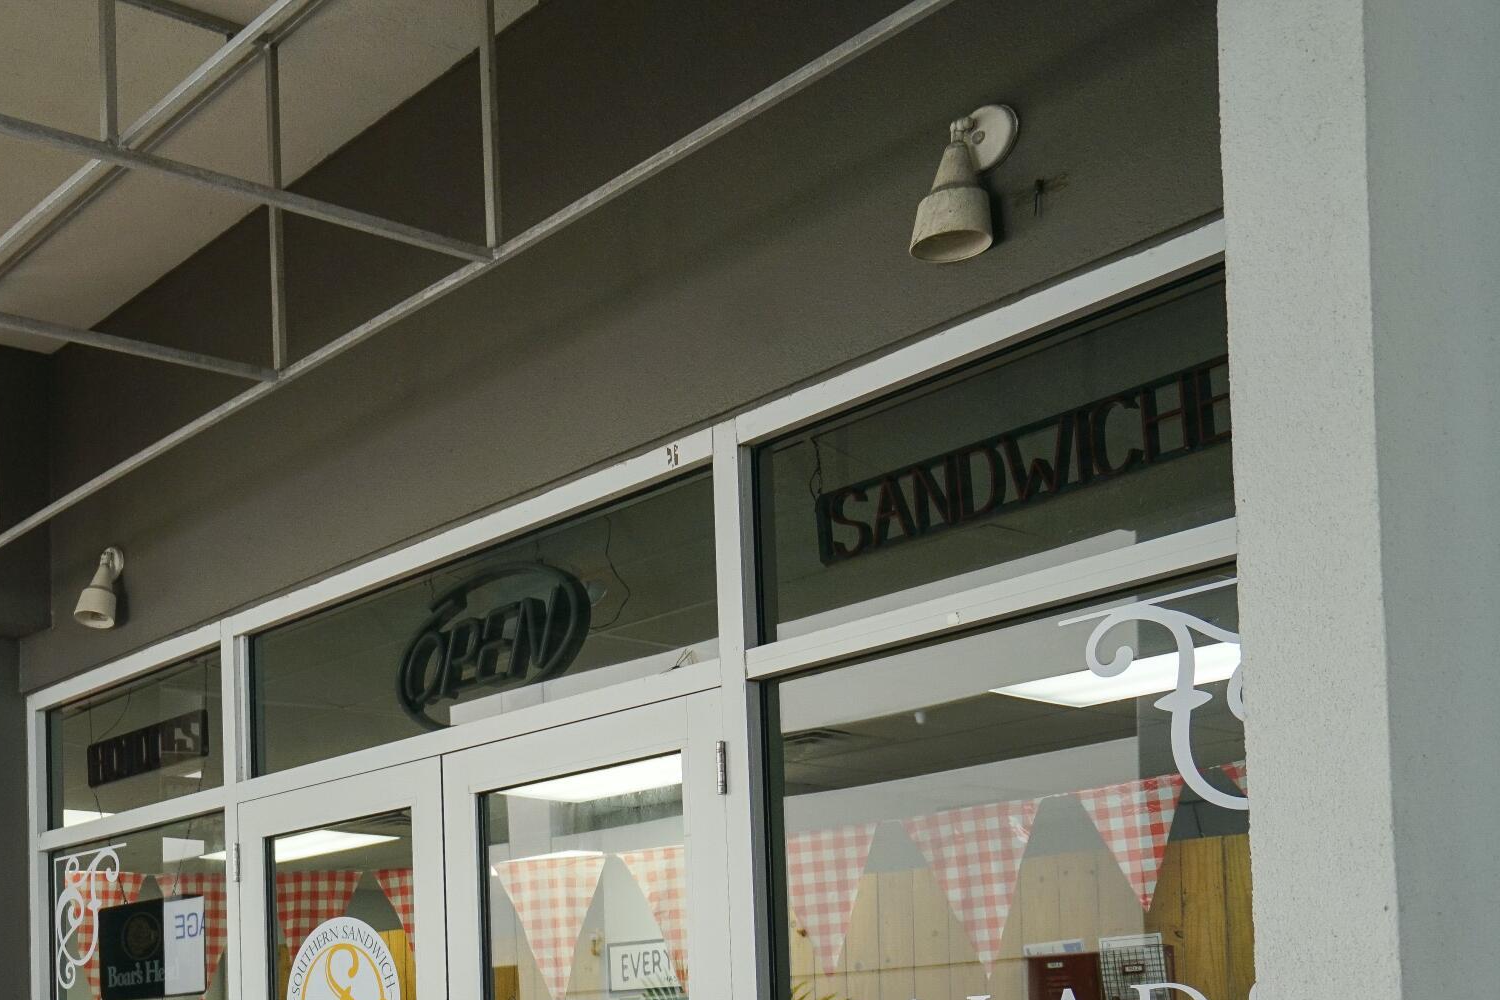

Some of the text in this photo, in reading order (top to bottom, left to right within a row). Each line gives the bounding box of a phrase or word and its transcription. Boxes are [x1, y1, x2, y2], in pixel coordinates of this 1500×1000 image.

[405, 583, 565, 704] OPEN
[107, 962, 144, 987] Boar's
[292, 925, 396, 996] SOUTHERN SANDWICH
